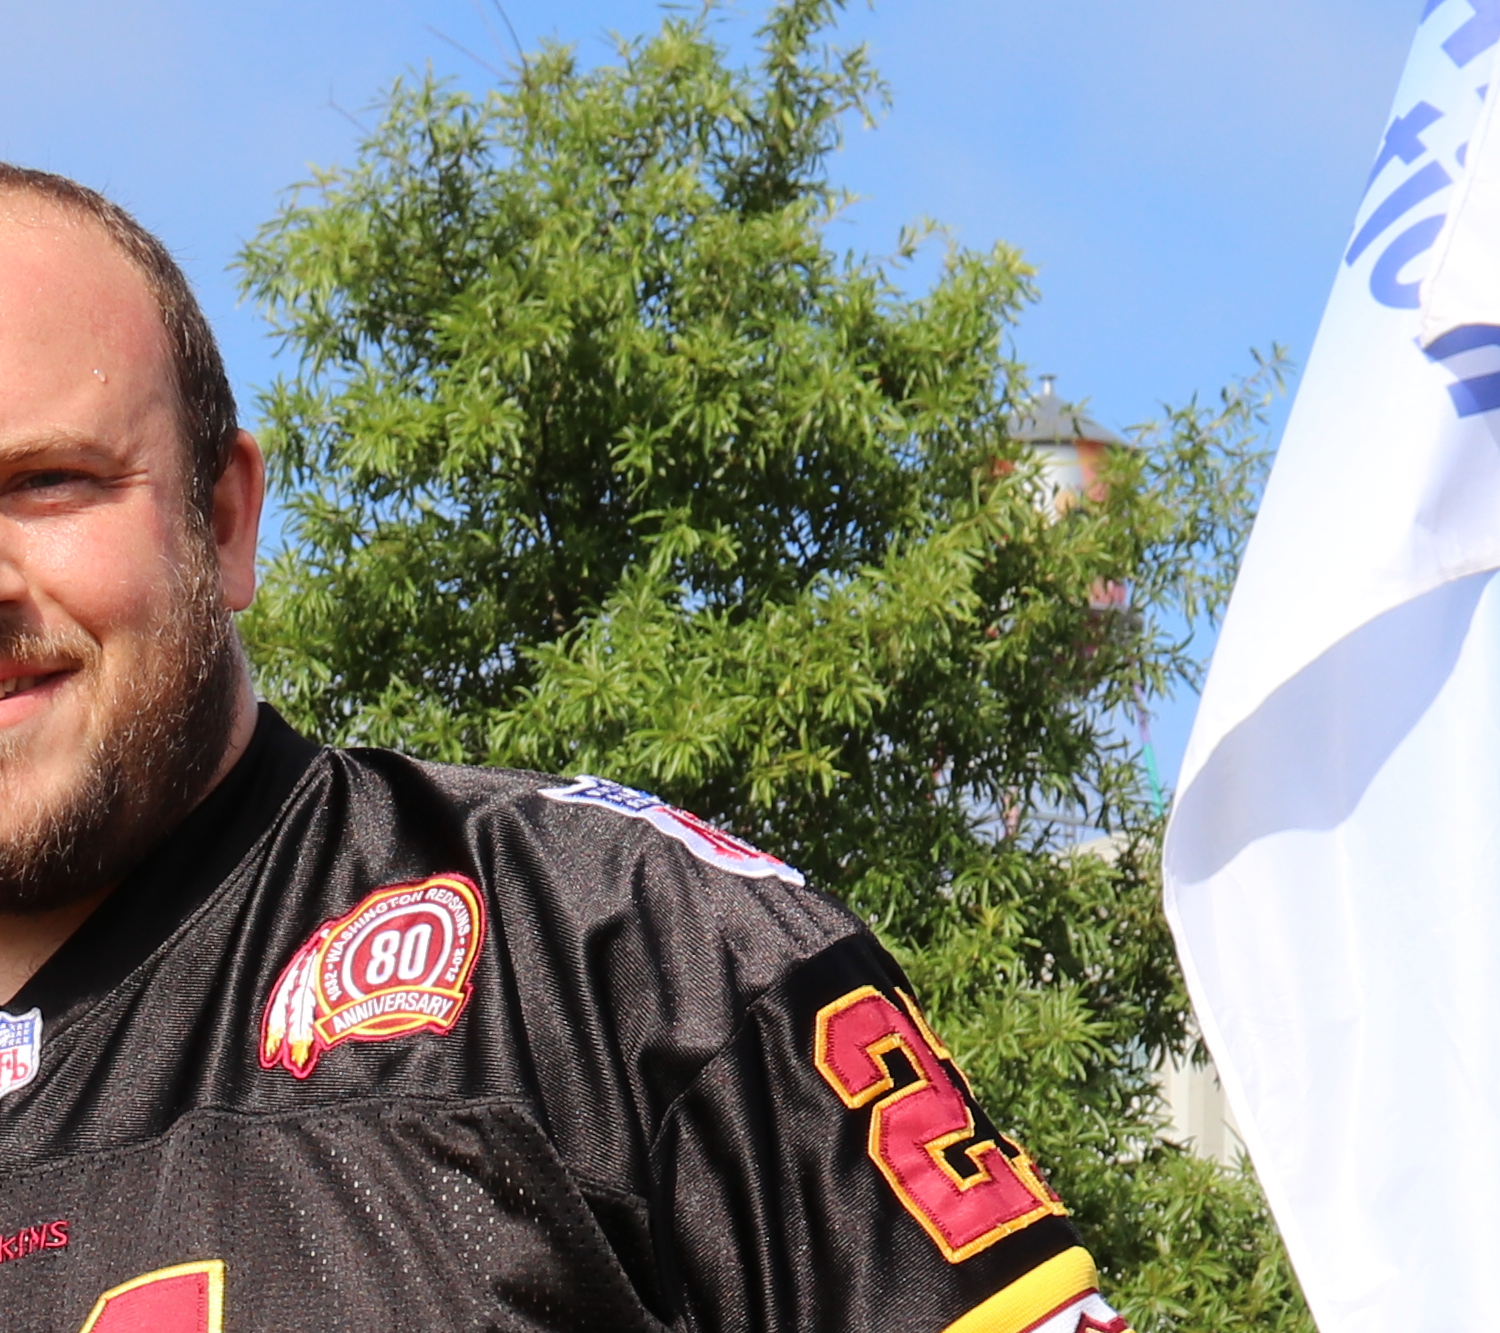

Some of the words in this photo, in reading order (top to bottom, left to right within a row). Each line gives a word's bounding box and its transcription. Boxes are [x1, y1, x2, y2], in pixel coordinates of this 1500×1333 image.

[325, 890, 425, 964] WASHINGTON
[425, 887, 472, 937] REDSKINS
[365, 923, 434, 985] 80
[331, 992, 454, 1034] ANNIVERSARY
